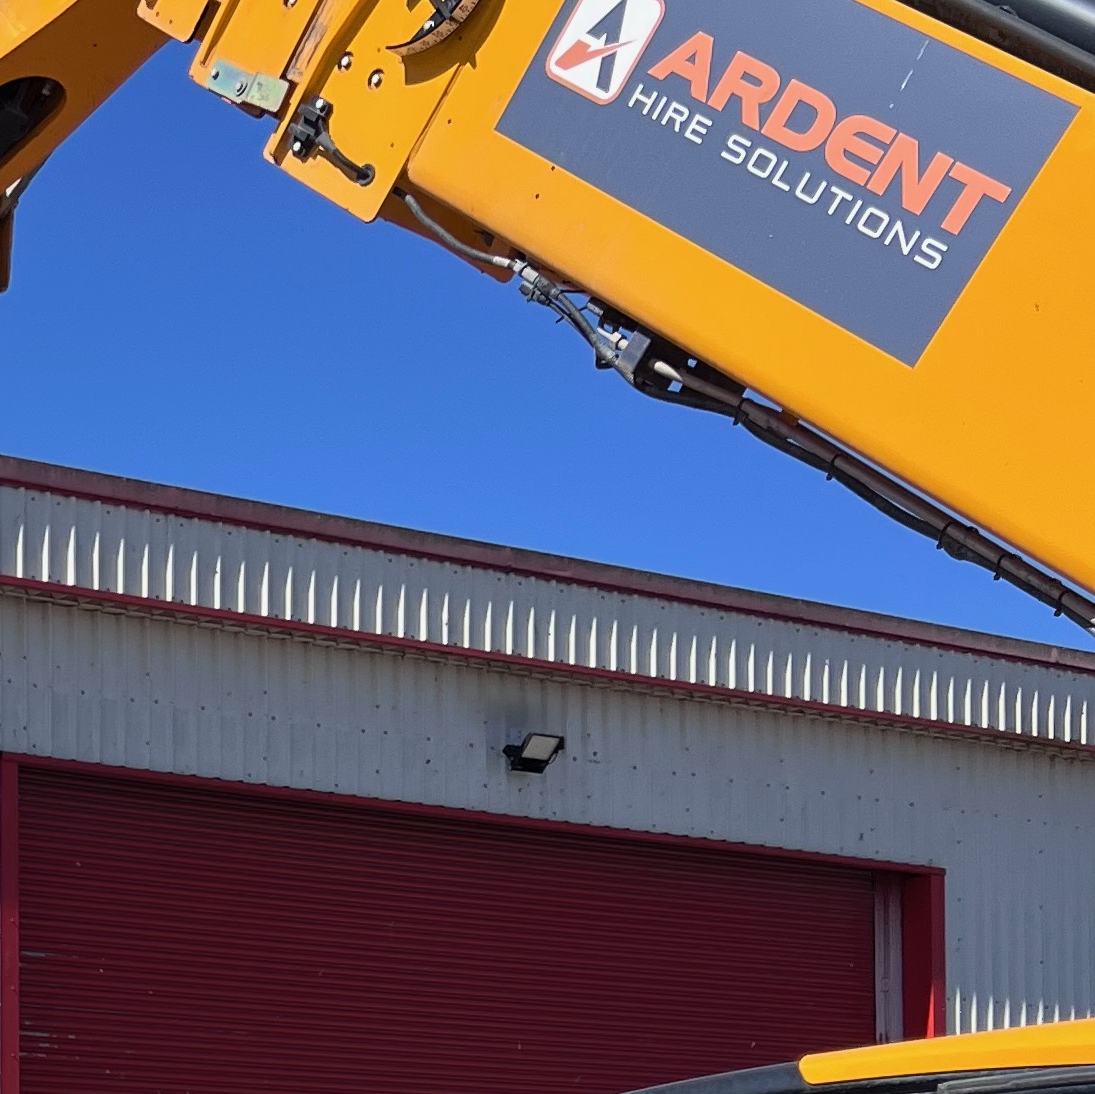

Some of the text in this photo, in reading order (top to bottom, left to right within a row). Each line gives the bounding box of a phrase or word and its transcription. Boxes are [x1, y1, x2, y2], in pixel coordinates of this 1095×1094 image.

[628, 83, 949, 270] HIRE SOLUTIONS
[648, 31, 1011, 236] ARDENT
